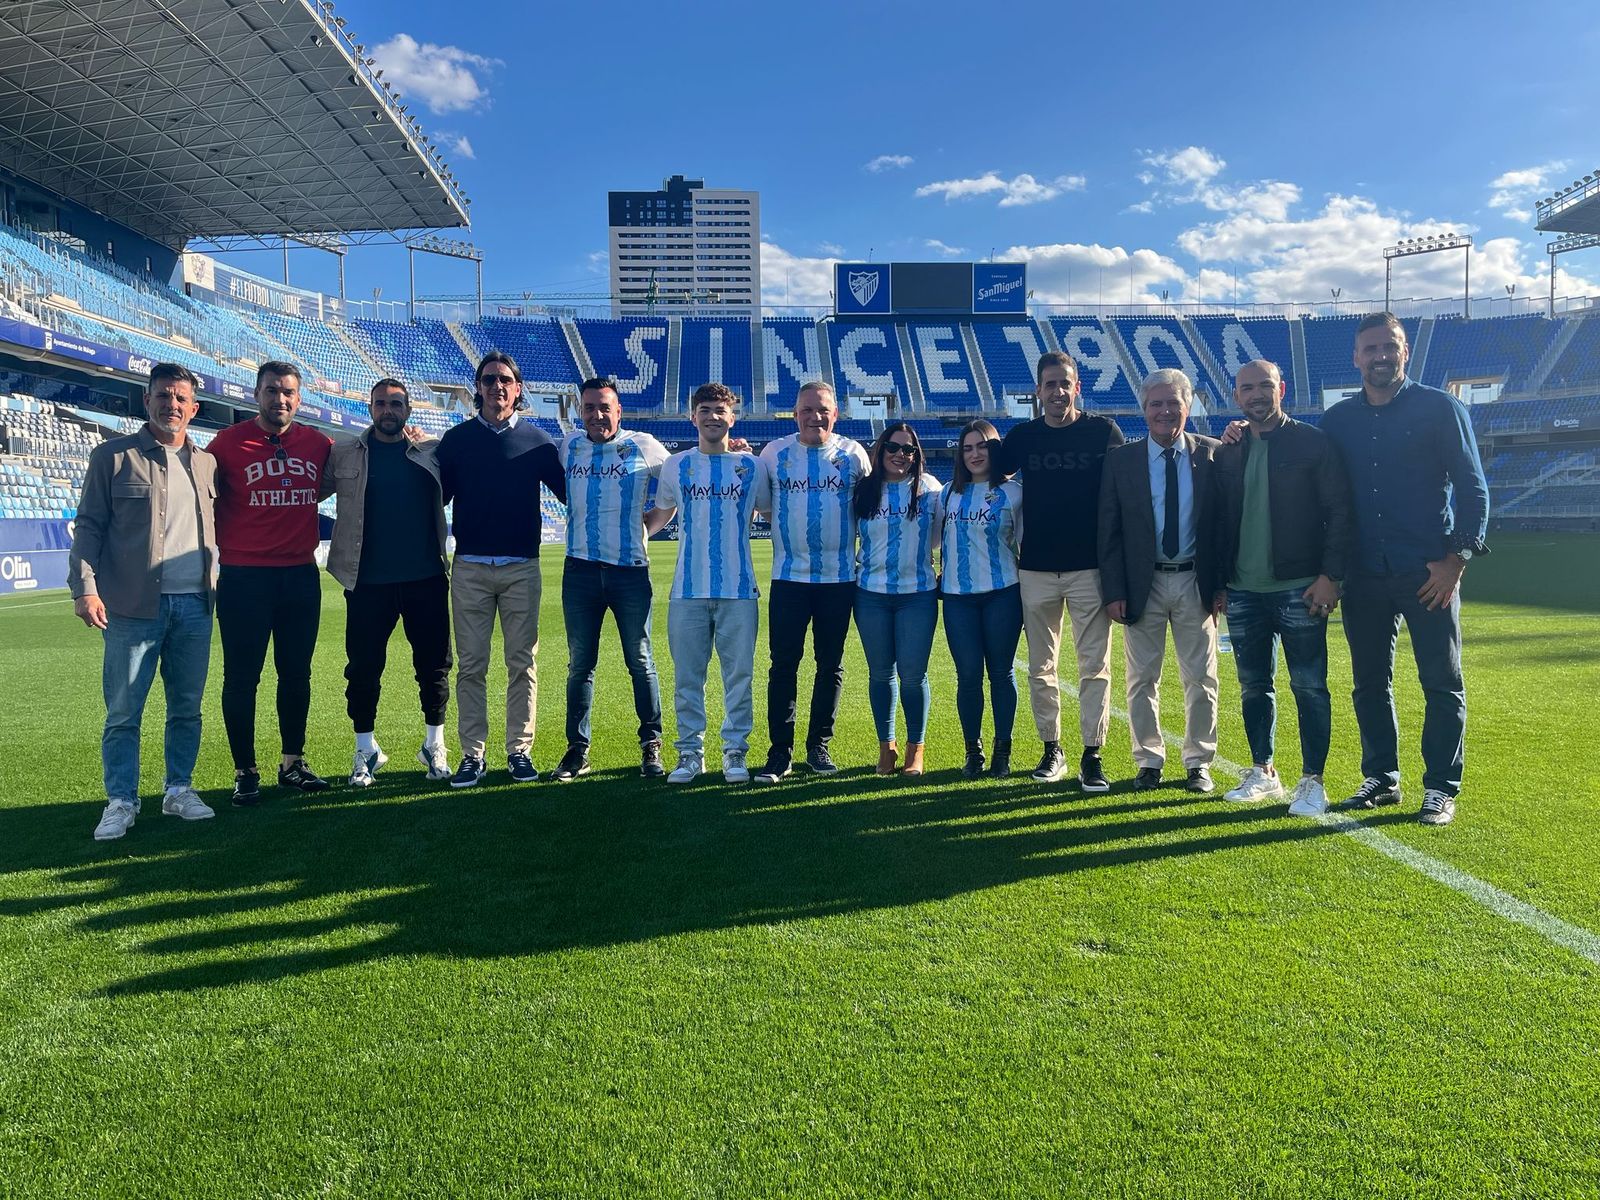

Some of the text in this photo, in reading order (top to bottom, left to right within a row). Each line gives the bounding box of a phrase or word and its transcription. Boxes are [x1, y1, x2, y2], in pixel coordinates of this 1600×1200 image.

[608, 326, 970, 396] SINCE
[244, 457, 318, 486] BOSS
[1028, 452, 1092, 471] BOSS
[248, 488, 317, 506] ATHLETIC
[1, 556, 32, 580] Olin
